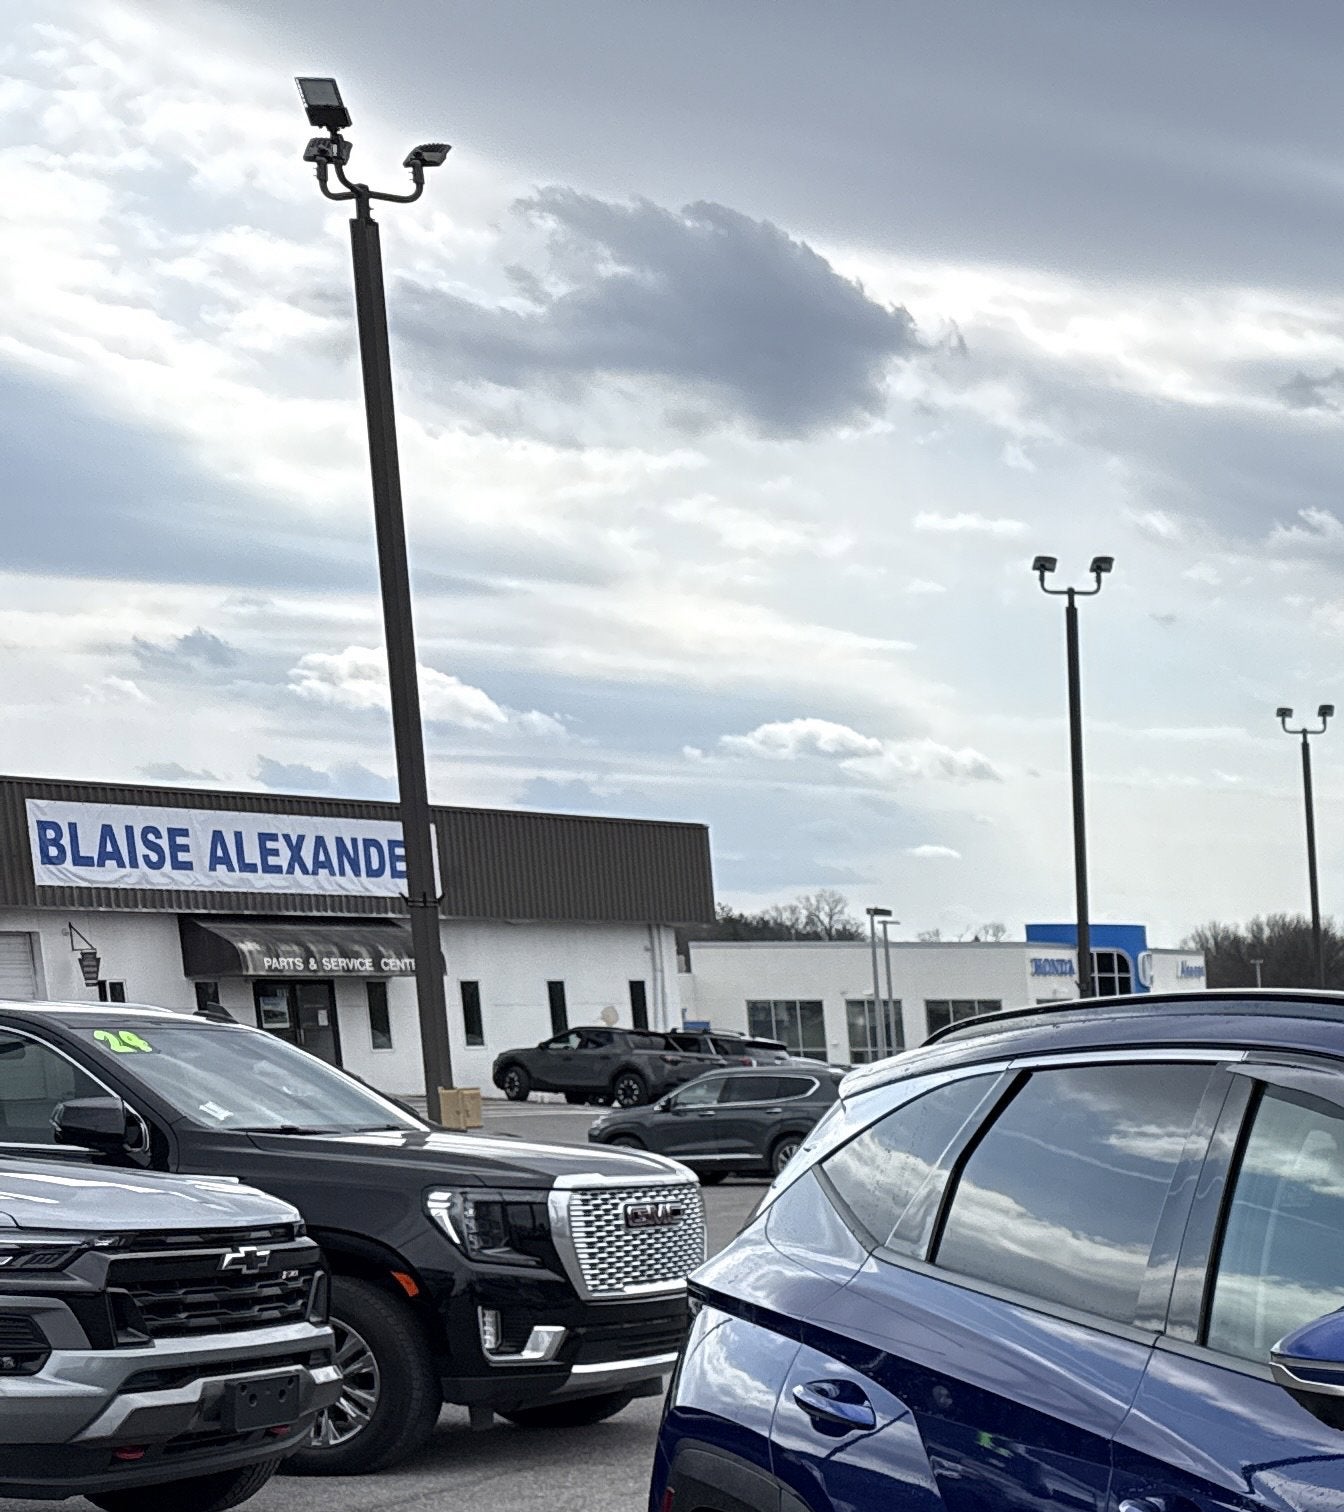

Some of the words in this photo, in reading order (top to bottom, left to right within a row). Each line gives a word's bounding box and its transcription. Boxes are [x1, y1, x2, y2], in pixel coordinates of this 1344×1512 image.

[36, 819, 195, 871] BLAISE
[208, 830, 408, 880] ALEXANDE
[263, 957, 304, 971] PARTS
[308, 957, 317, 970] &
[322, 957, 374, 971] SERVICE
[626, 1202, 682, 1227] GMC
